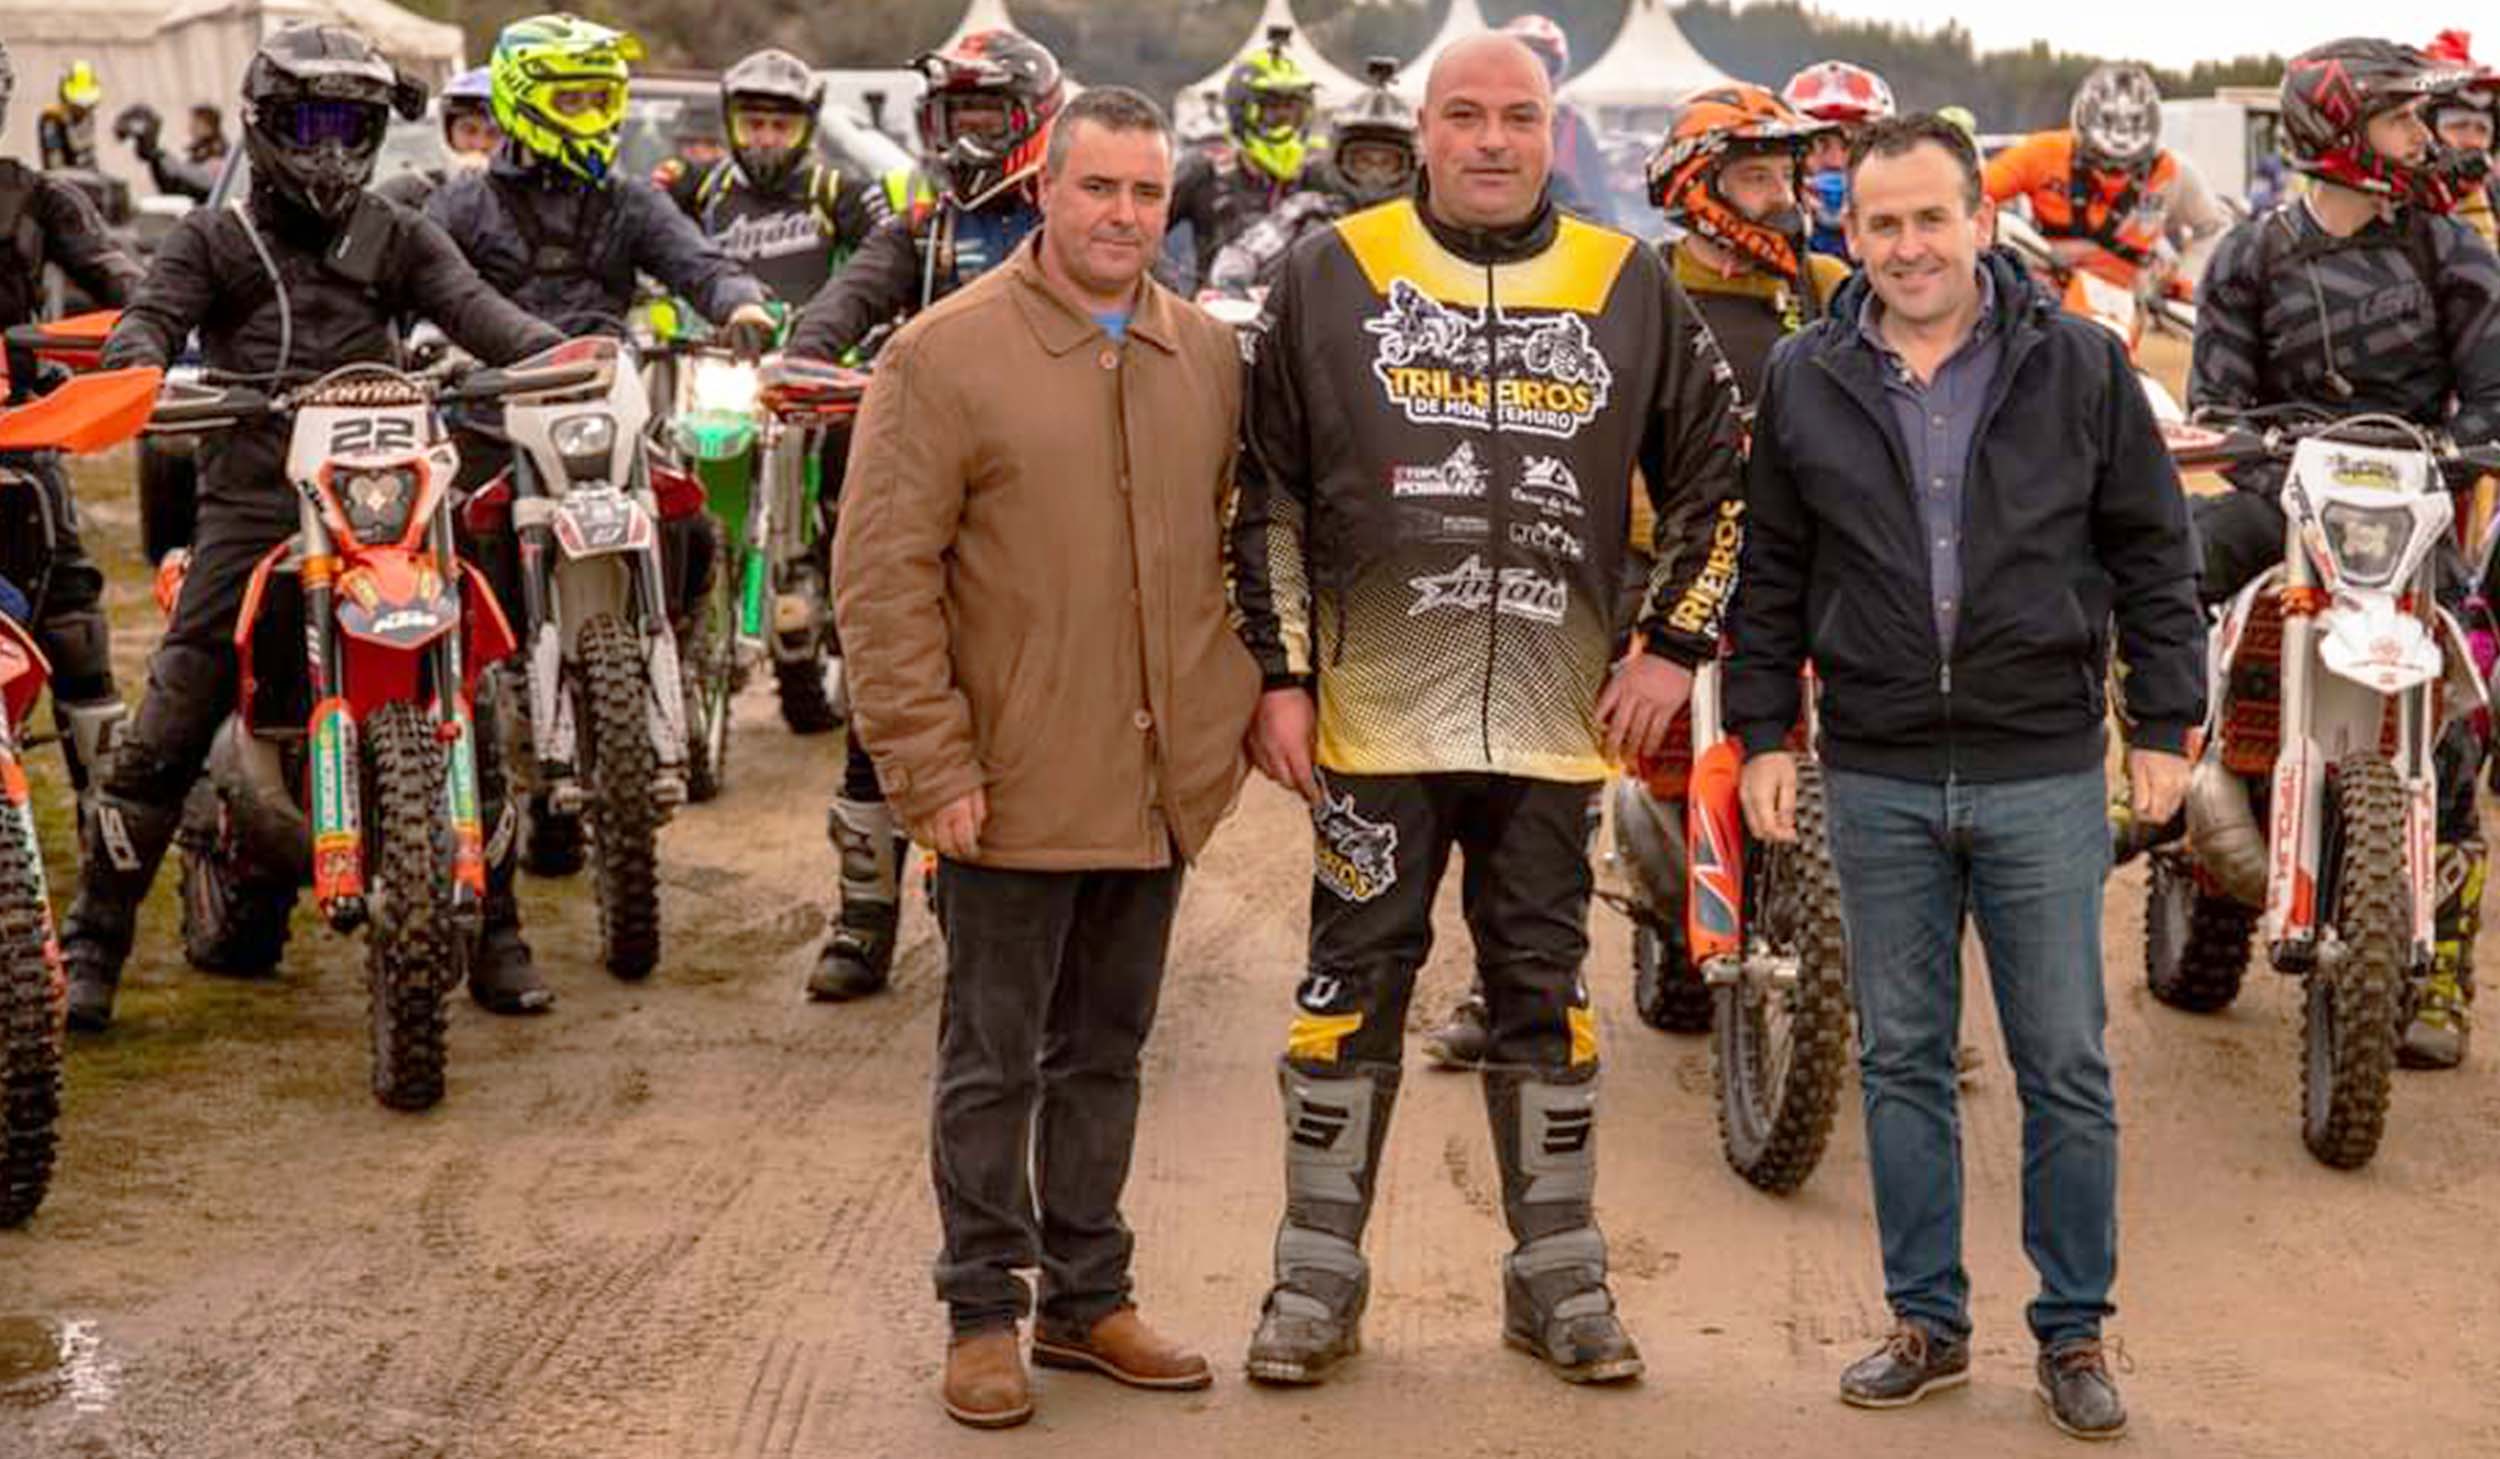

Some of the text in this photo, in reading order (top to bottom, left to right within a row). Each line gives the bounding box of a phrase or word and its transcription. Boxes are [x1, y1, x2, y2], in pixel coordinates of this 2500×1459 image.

[1387, 367, 1591, 414] TRILHEIROS
[1415, 398, 1439, 414] DE
[331, 416, 415, 455] 22
